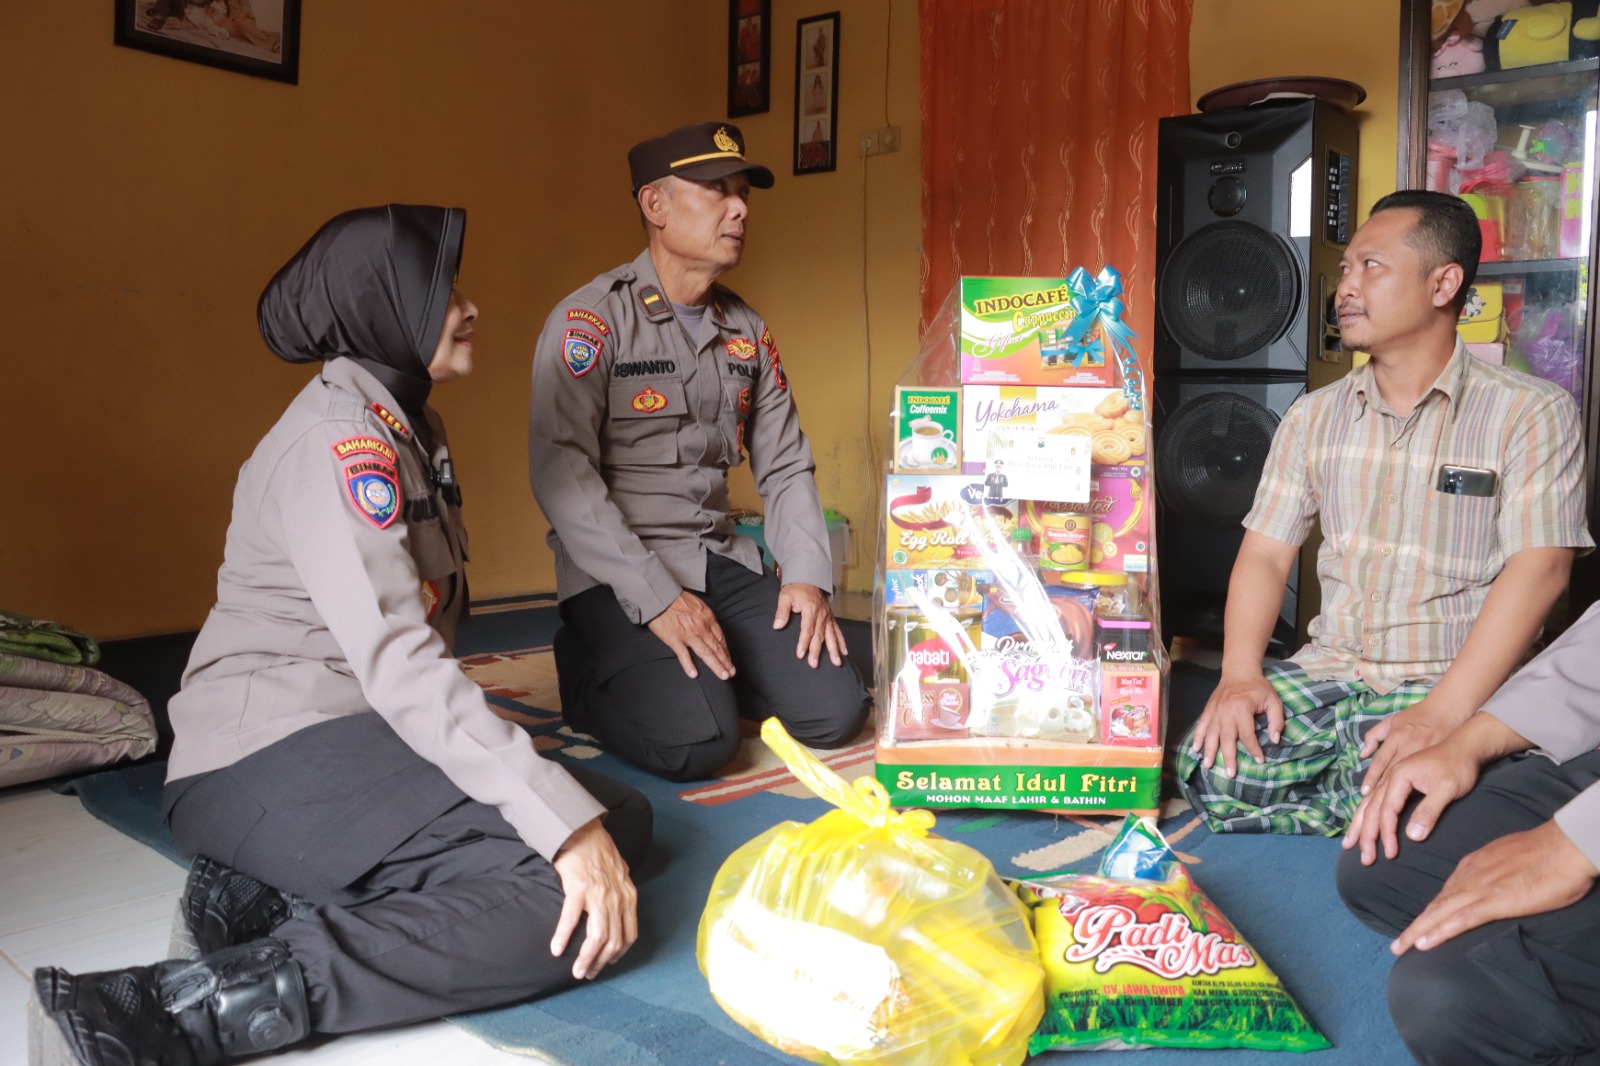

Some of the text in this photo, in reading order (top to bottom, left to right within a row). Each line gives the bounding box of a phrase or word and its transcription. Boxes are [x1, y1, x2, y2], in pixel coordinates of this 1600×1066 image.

[976, 286, 1069, 315] INDOCAFÉ
[569, 311, 606, 332] BAHARKAM
[1012, 306, 1076, 333] Cappuccin
[569, 330, 599, 346] BINMAS
[614, 359, 676, 378] ISWANTO
[909, 404, 948, 416] Coffeemix
[975, 397, 1061, 431] Yokohama
[338, 438, 393, 459] BAHARKAM
[350, 462, 395, 477] BINMAS
[900, 529, 968, 551] Egg Roll
[896, 771, 1137, 794] Selamat Idul Fitri
[926, 795, 1106, 805] MOHON MAAF LAHIR & BATHIN
[1065, 904, 1256, 978] Padi Mas
[1103, 984, 1120, 995] CV.
[1122, 984, 1150, 996] JAWA
[1151, 984, 1186, 997] DWIPA
